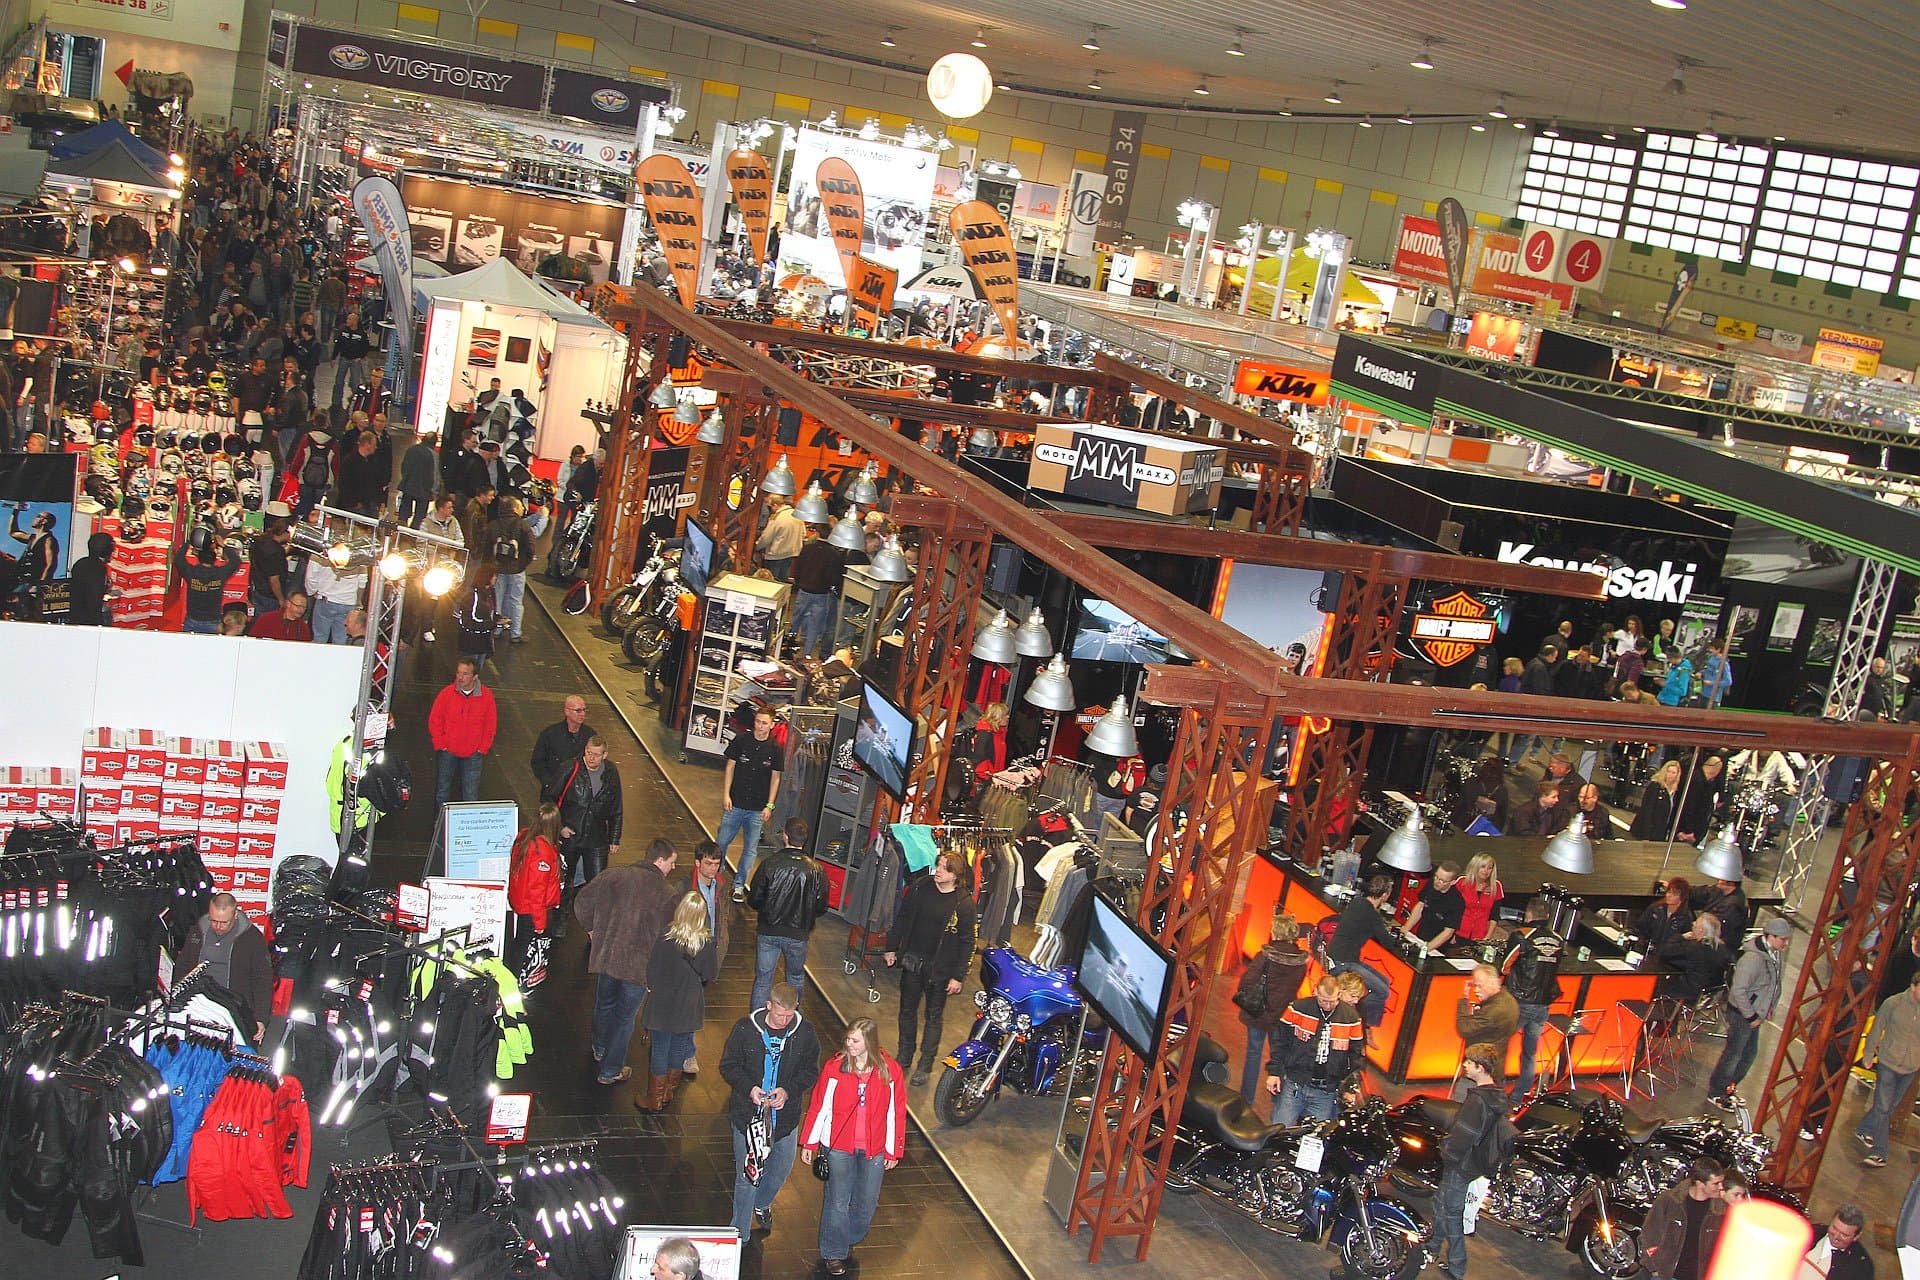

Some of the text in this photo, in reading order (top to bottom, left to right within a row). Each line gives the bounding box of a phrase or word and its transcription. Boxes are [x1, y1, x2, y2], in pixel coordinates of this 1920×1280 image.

[374, 52, 512, 93] VICTORY
[1105, 127, 1136, 206] Saal 34
[1531, 239, 1546, 265] 4
[1574, 249, 1591, 275] 4
[858, 271, 886, 300] KTM
[926, 276, 964, 289] KTM
[1467, 345, 1512, 363] REMUS
[1256, 372, 1318, 399] KTM
[1354, 355, 1417, 391] Kawasaki
[1042, 449, 1075, 461] MOTO
[1135, 466, 1171, 481] MAXX
[1439, 597, 1480, 618] MOTOR
